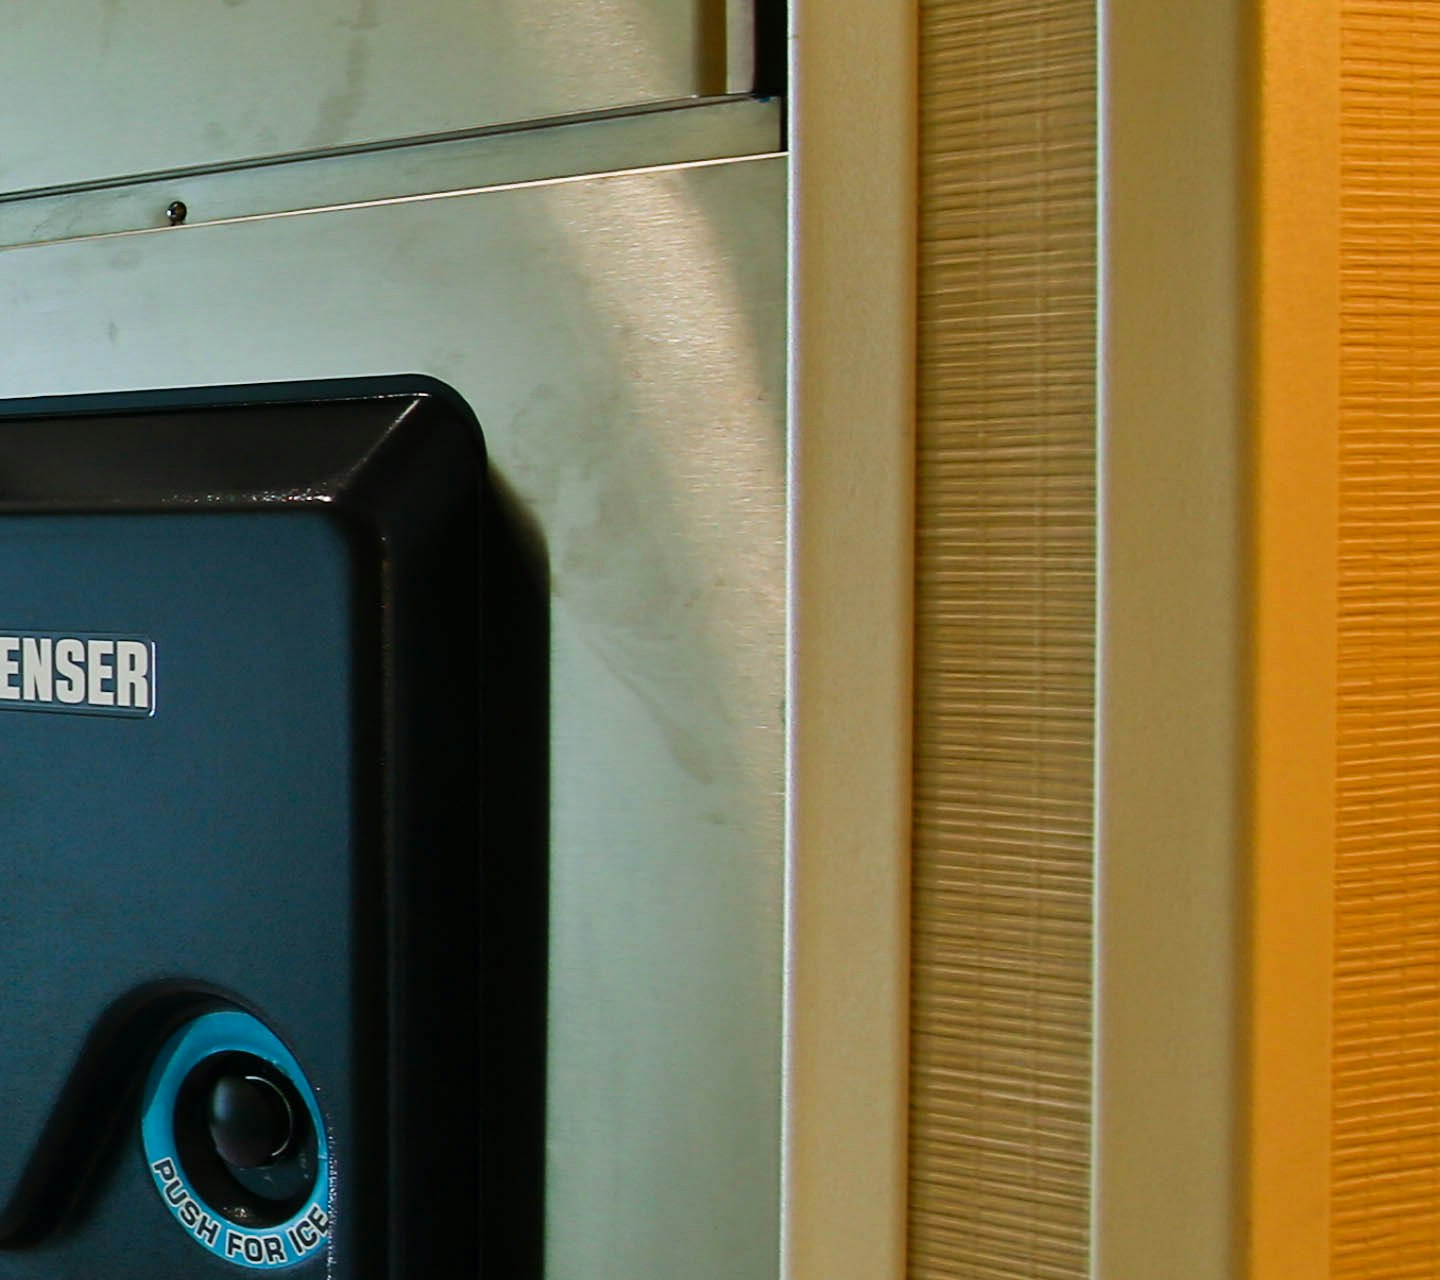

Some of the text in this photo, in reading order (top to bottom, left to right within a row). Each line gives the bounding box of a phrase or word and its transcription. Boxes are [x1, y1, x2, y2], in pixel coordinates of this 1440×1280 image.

[152, 1157, 329, 1264] PUSH FOR ICE
